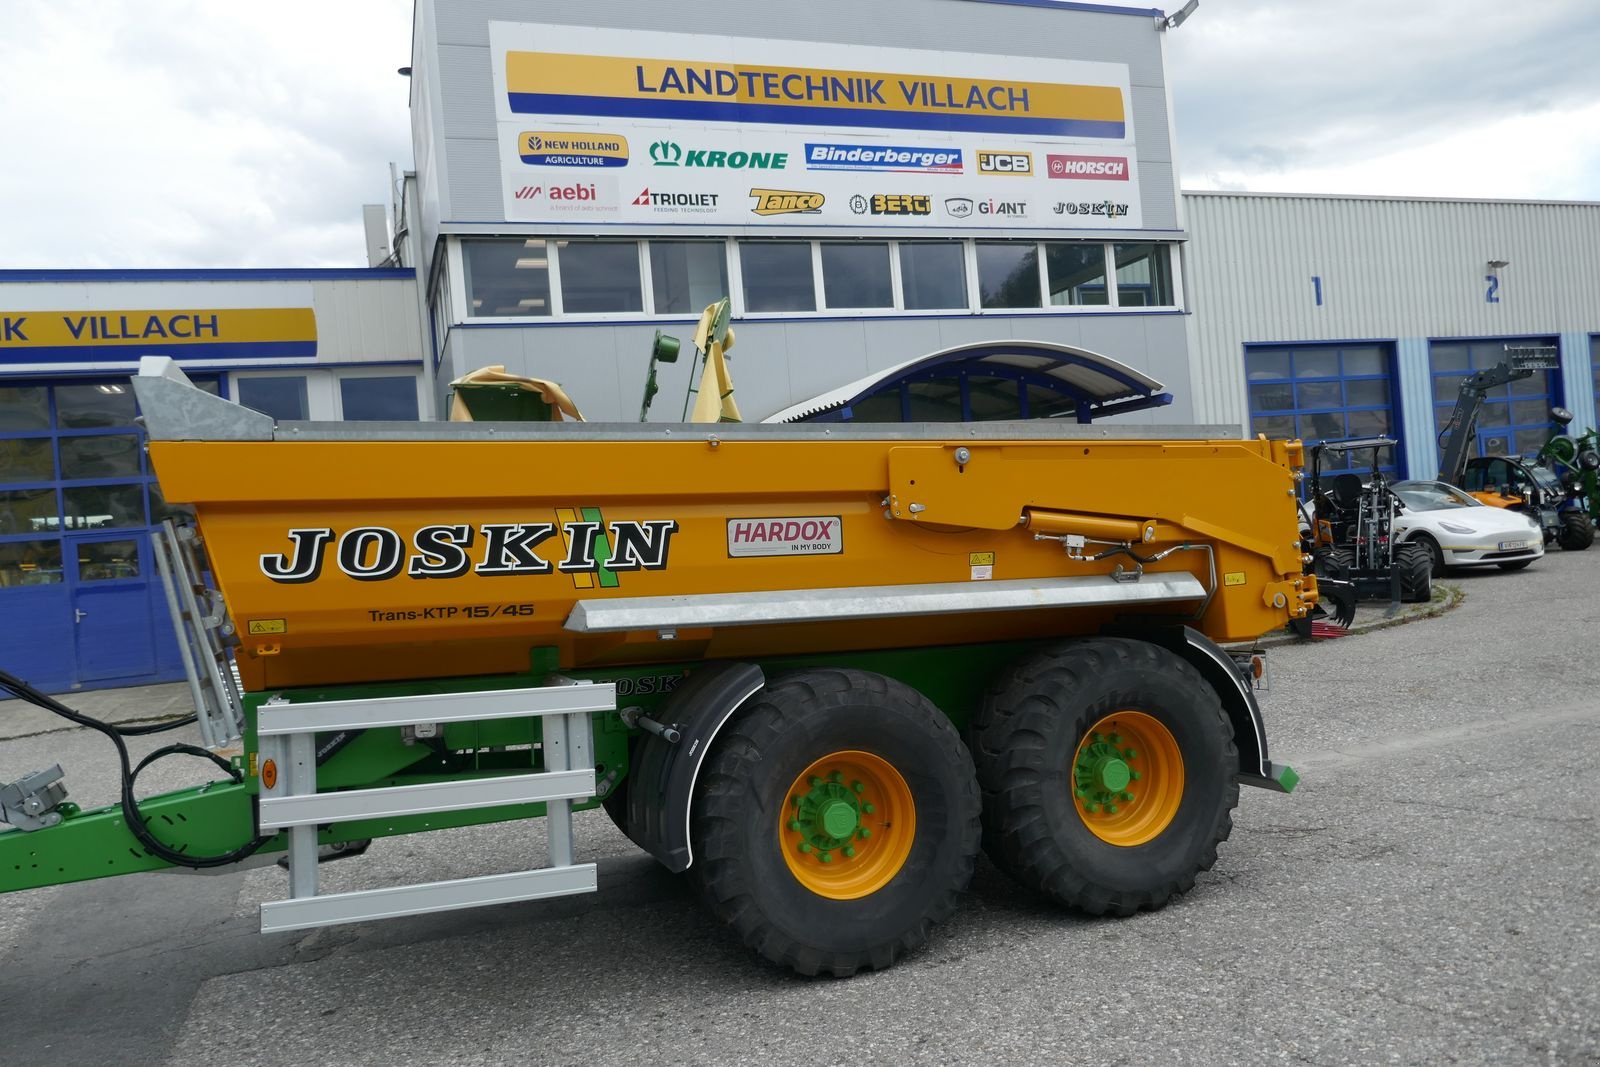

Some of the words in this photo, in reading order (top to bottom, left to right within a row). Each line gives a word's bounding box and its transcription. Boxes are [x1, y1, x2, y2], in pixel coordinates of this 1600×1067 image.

[635, 66, 886, 105] LANDTECHNIK
[898, 80, 1030, 112] VILLACH
[544, 140, 569, 150] NEW
[572, 141, 620, 152] HOLLAND
[545, 155, 604, 166] AGRICULTURE
[685, 150, 789, 170] KRONE
[810, 146, 959, 167] Binderberger
[980, 154, 1029, 172] JCB
[1065, 161, 1124, 175] HORSCH
[549, 183, 596, 200] aebi
[650, 193, 719, 206] TRIOLIET
[749, 188, 825, 210] Tanco
[1053, 201, 1129, 217] JOSKIN
[1311, 276, 1323, 306] 1
[1485, 275, 1500, 303] 2
[63, 315, 219, 340] VILLACH
[259, 520, 679, 583] JOSKIN
[812, 543, 832, 551] BODY
[368, 606, 458, 622] Trans-KTP
[461, 604, 535, 618] 15/45
